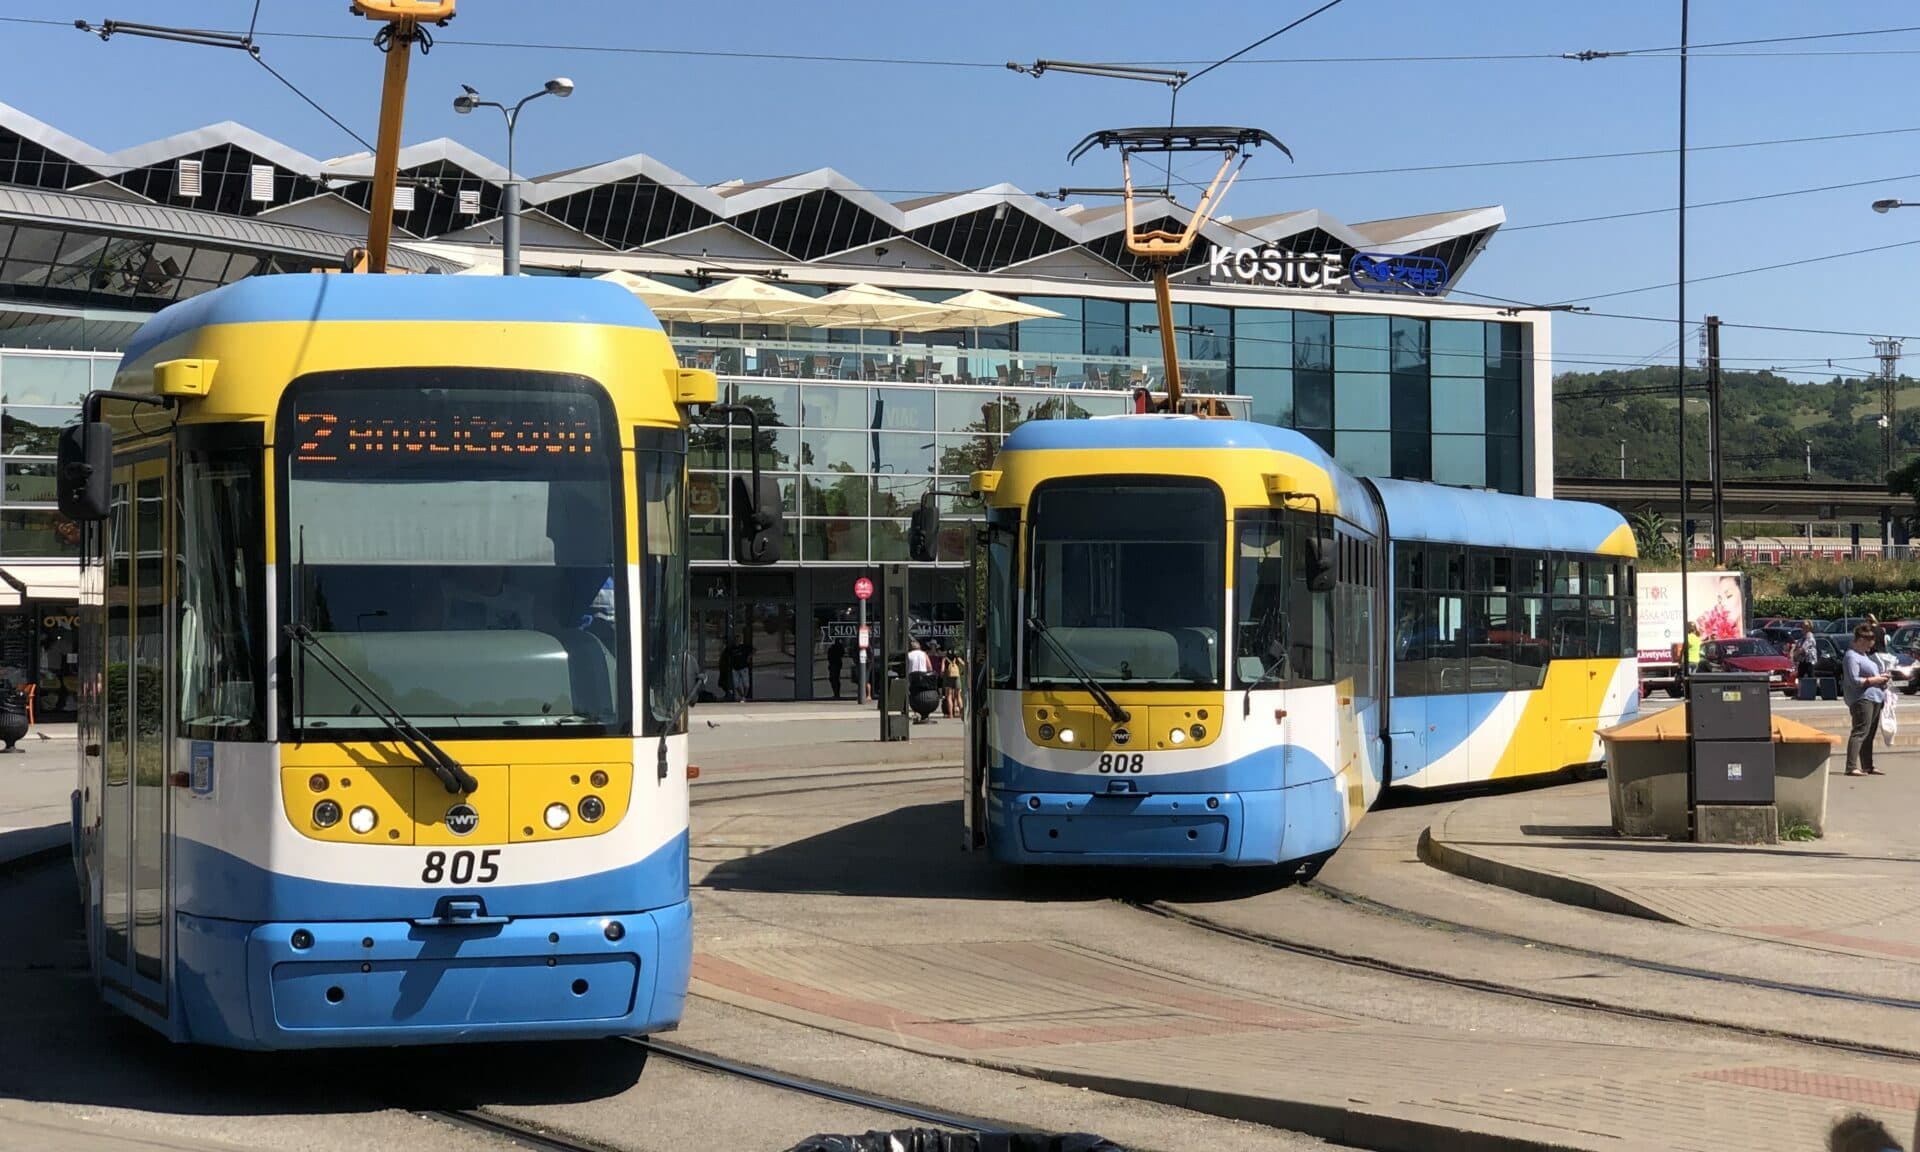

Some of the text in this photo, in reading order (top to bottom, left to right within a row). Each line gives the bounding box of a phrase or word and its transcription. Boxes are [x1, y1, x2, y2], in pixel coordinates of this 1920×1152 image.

[298, 413, 337, 460] 2
[1098, 753, 1144, 774] 808
[421, 849, 501, 884] 805
